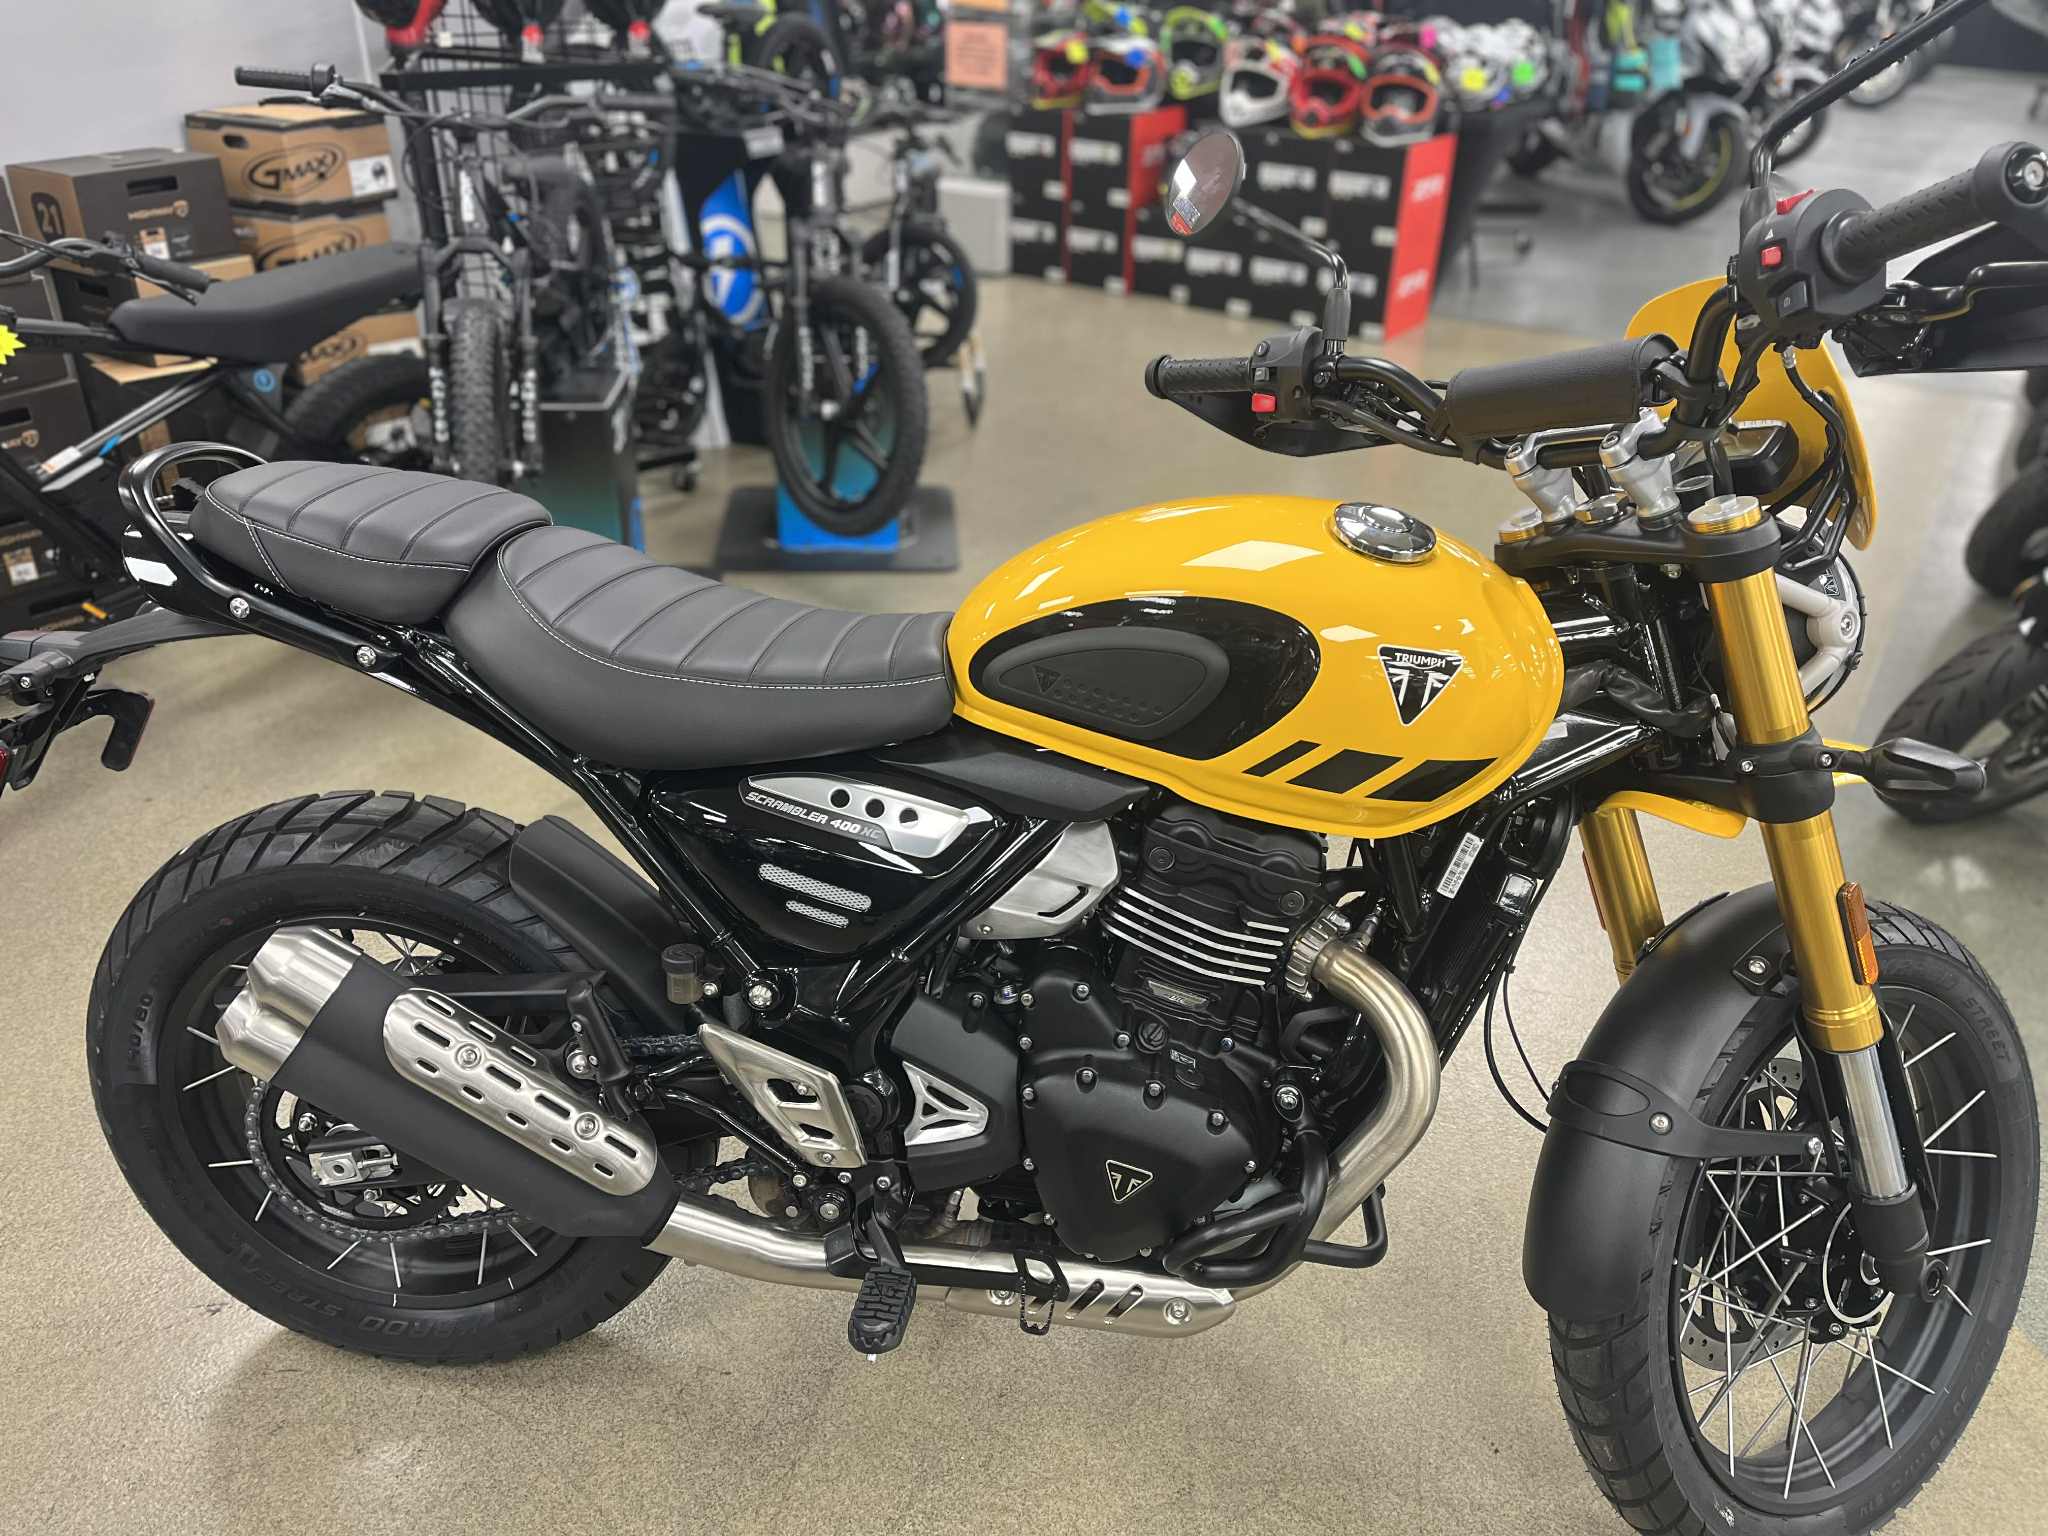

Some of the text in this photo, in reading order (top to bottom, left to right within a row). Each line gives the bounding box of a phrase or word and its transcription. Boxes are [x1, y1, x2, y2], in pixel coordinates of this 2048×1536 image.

[249, 151, 338, 191] GMAX
[37, 201, 63, 235] 21
[1394, 652, 1446, 669] TRIUMPH
[746, 792, 882, 839] SCRAMBLER 400 XC
[1962, 996, 2011, 1063] STREET
